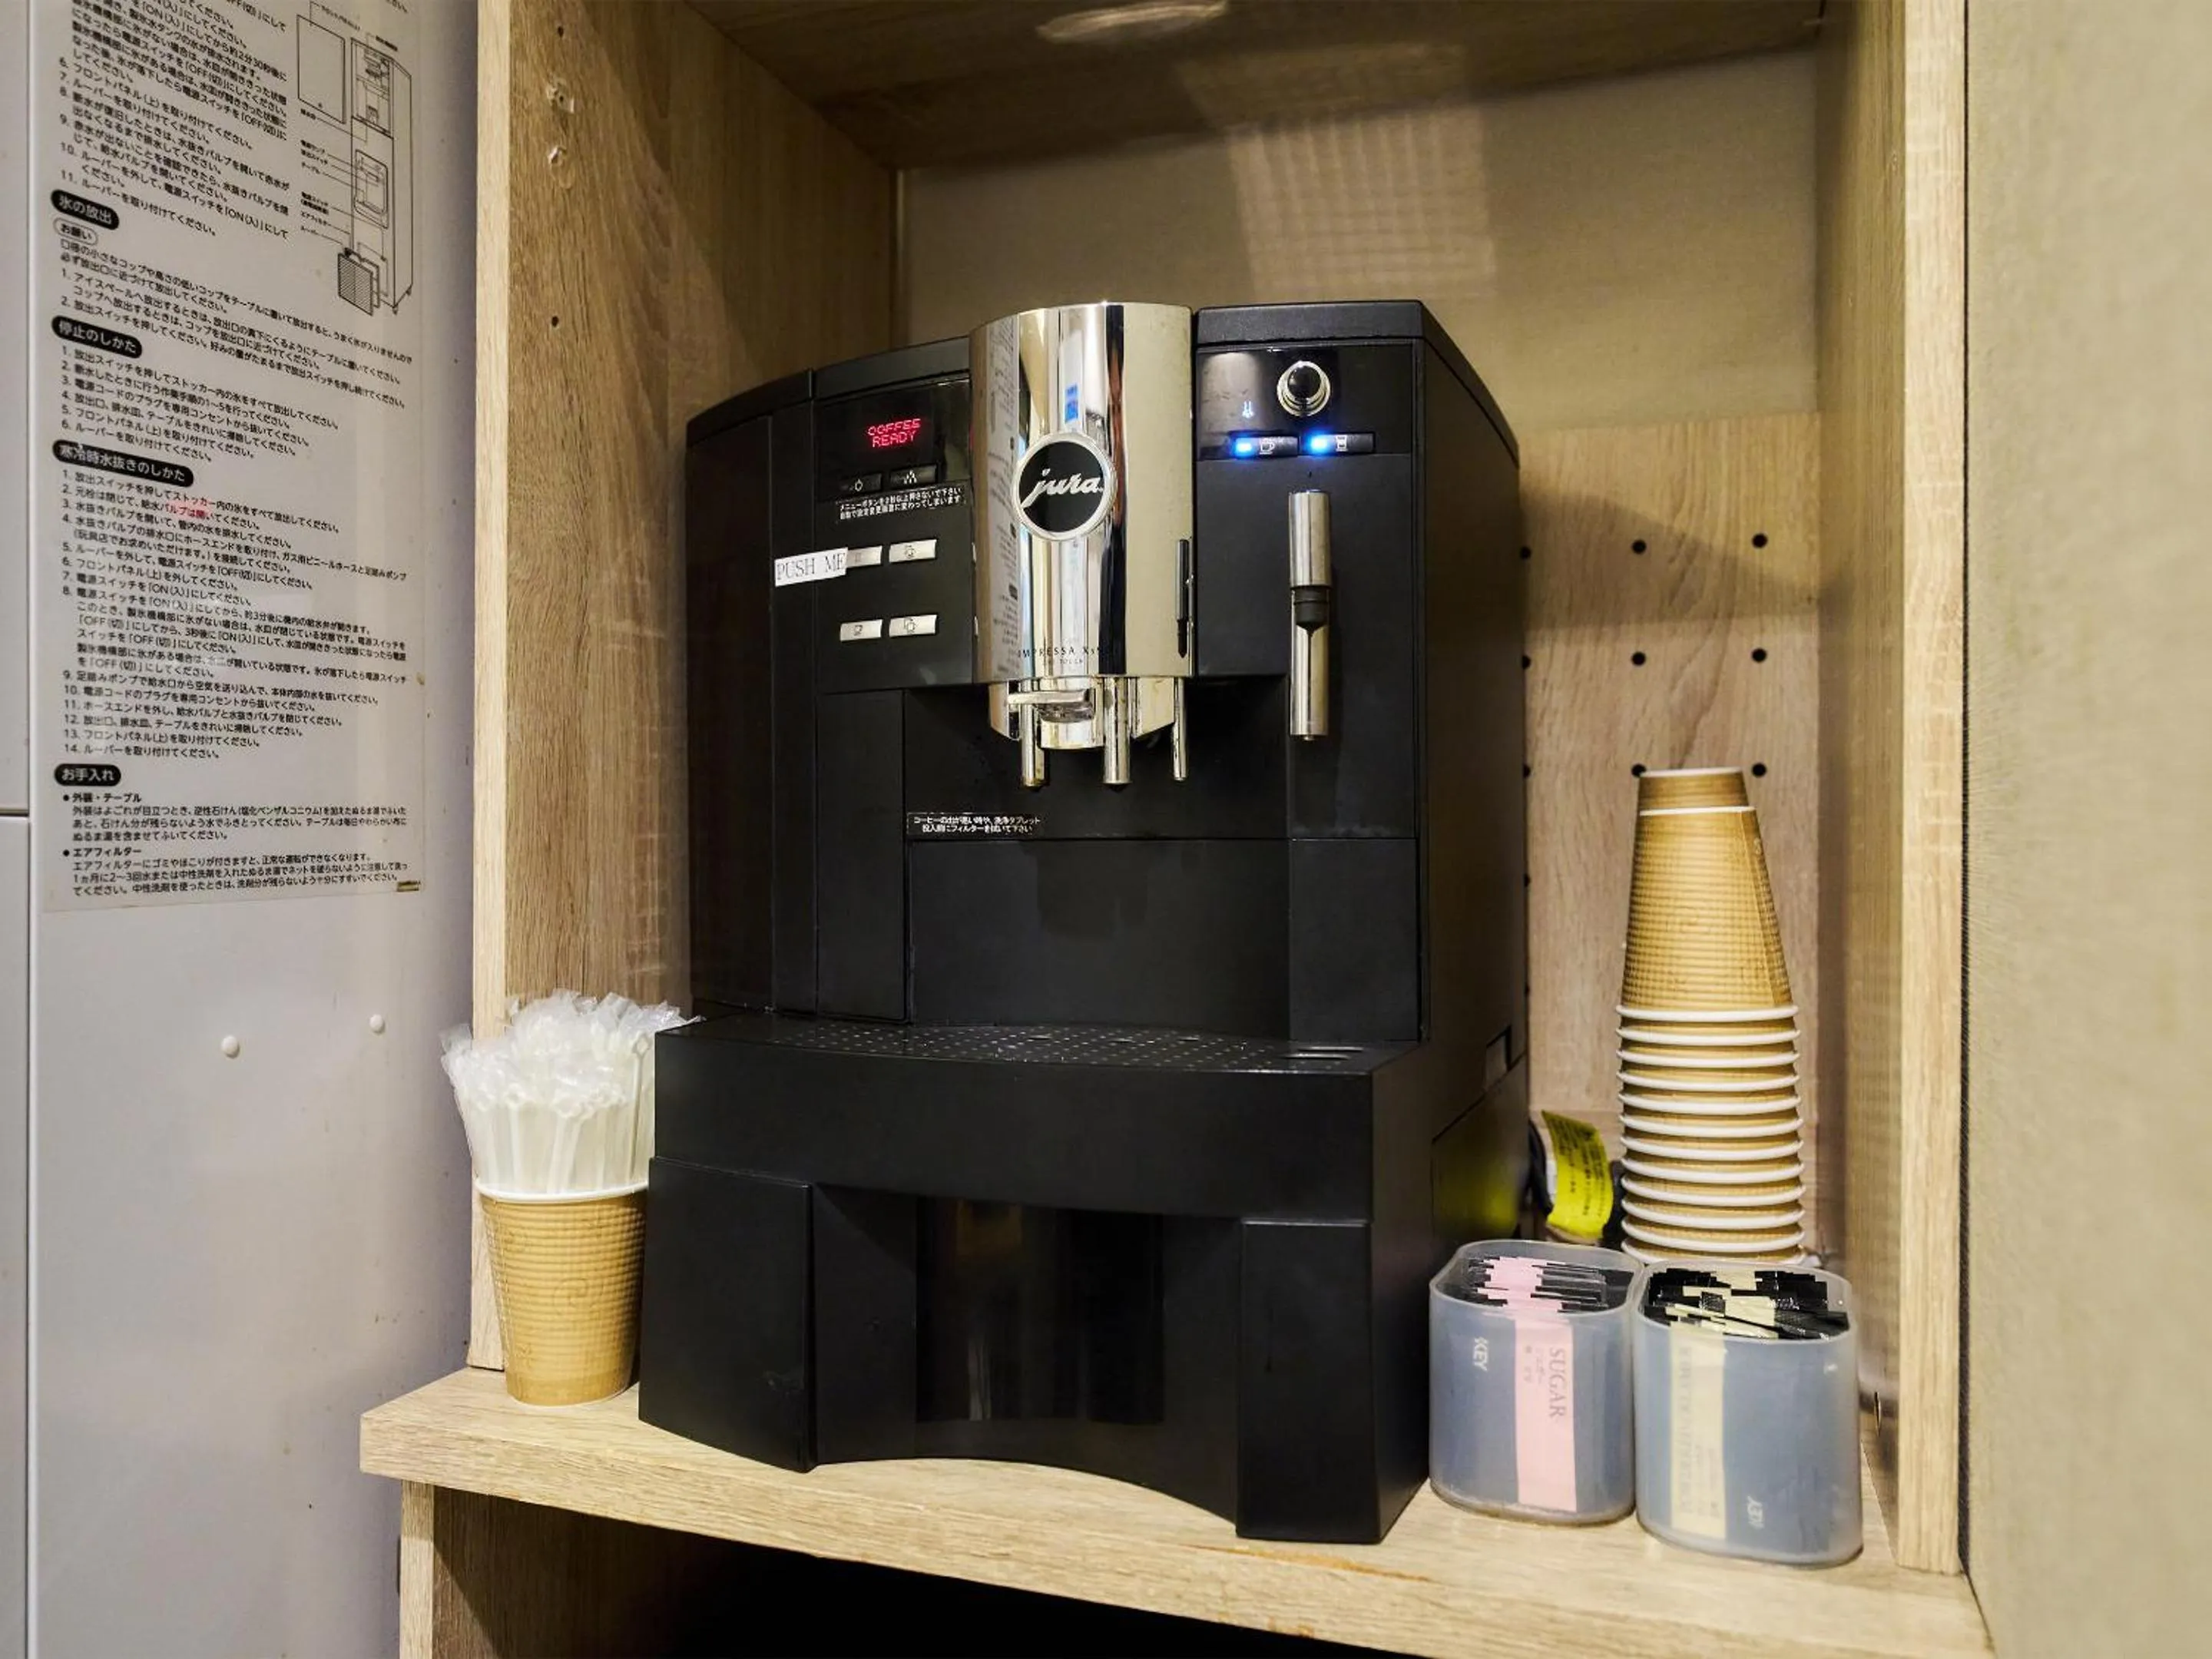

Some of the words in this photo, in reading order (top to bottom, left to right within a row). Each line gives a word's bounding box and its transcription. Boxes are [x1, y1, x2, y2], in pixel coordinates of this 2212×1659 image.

[61, 198, 111, 223] 氷の放出
[60, 323, 134, 353] 停止のしかた
[866, 419, 922, 436] COFFEE
[872, 431, 917, 448] READY
[1021, 469, 1101, 508] jura
[777, 558, 815, 581] PUSH
[825, 552, 845, 573] ME
[65, 769, 112, 780] お手入れ
[73, 846, 141, 857] エアフィルター
[1548, 1346, 1567, 1419] SUGAR
